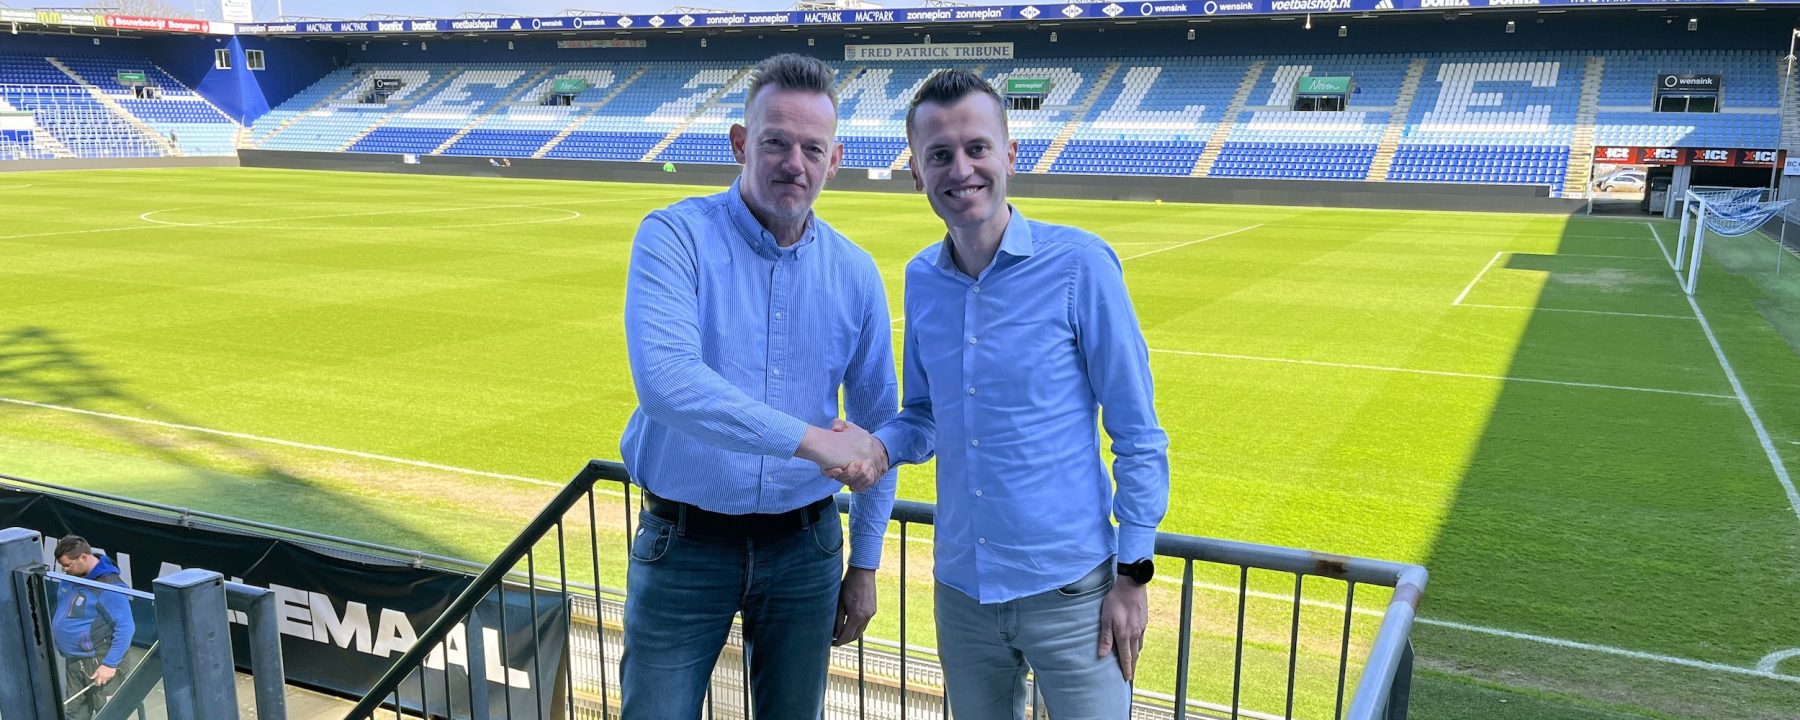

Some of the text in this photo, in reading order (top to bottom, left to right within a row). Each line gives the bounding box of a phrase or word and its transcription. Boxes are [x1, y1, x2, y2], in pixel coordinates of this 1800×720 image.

[1154, 4, 1187, 12] wensink
[1220, 3, 1253, 11] wensink
[706, 14, 746, 25] zonneplan
[749, 13, 790, 24] zonneplan
[907, 9, 953, 21] zonneplan
[956, 8, 1003, 20] zonneplan
[115, 17, 200, 31] Bouwbedrijf Bongers
[861, 46, 1010, 58] FRED PATRICK TRIBUNE
[1014, 82, 1044, 90] zonneplan
[1679, 77, 1713, 85] wensink
